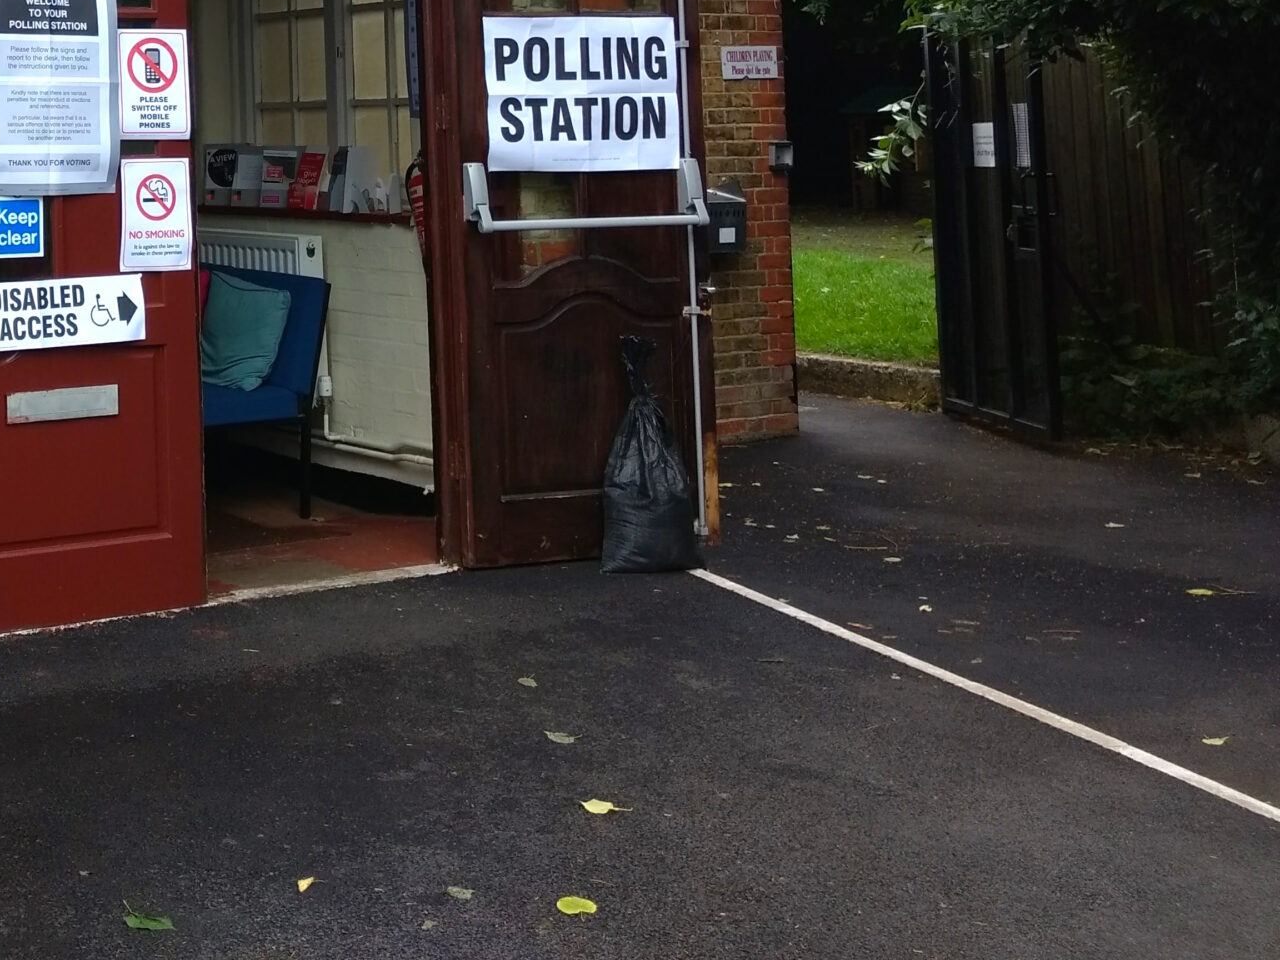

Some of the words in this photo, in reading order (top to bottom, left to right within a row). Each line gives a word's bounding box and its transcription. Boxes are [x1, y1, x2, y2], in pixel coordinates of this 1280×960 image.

[29, 9, 41, 17] TO
[44, 9, 67, 18] YOUR
[9, 20, 49, 29] POLLING
[51, 22, 87, 30] STATION
[494, 35, 668, 82] POLLING
[726, 51, 752, 62] CHILDREN
[753, 50, 773, 62] PLAYING
[500, 95, 666, 143] STATION
[129, 231, 143, 239] NO
[145, 229, 185, 239] SMOKING
[0, 313, 78, 341] ACCESS
